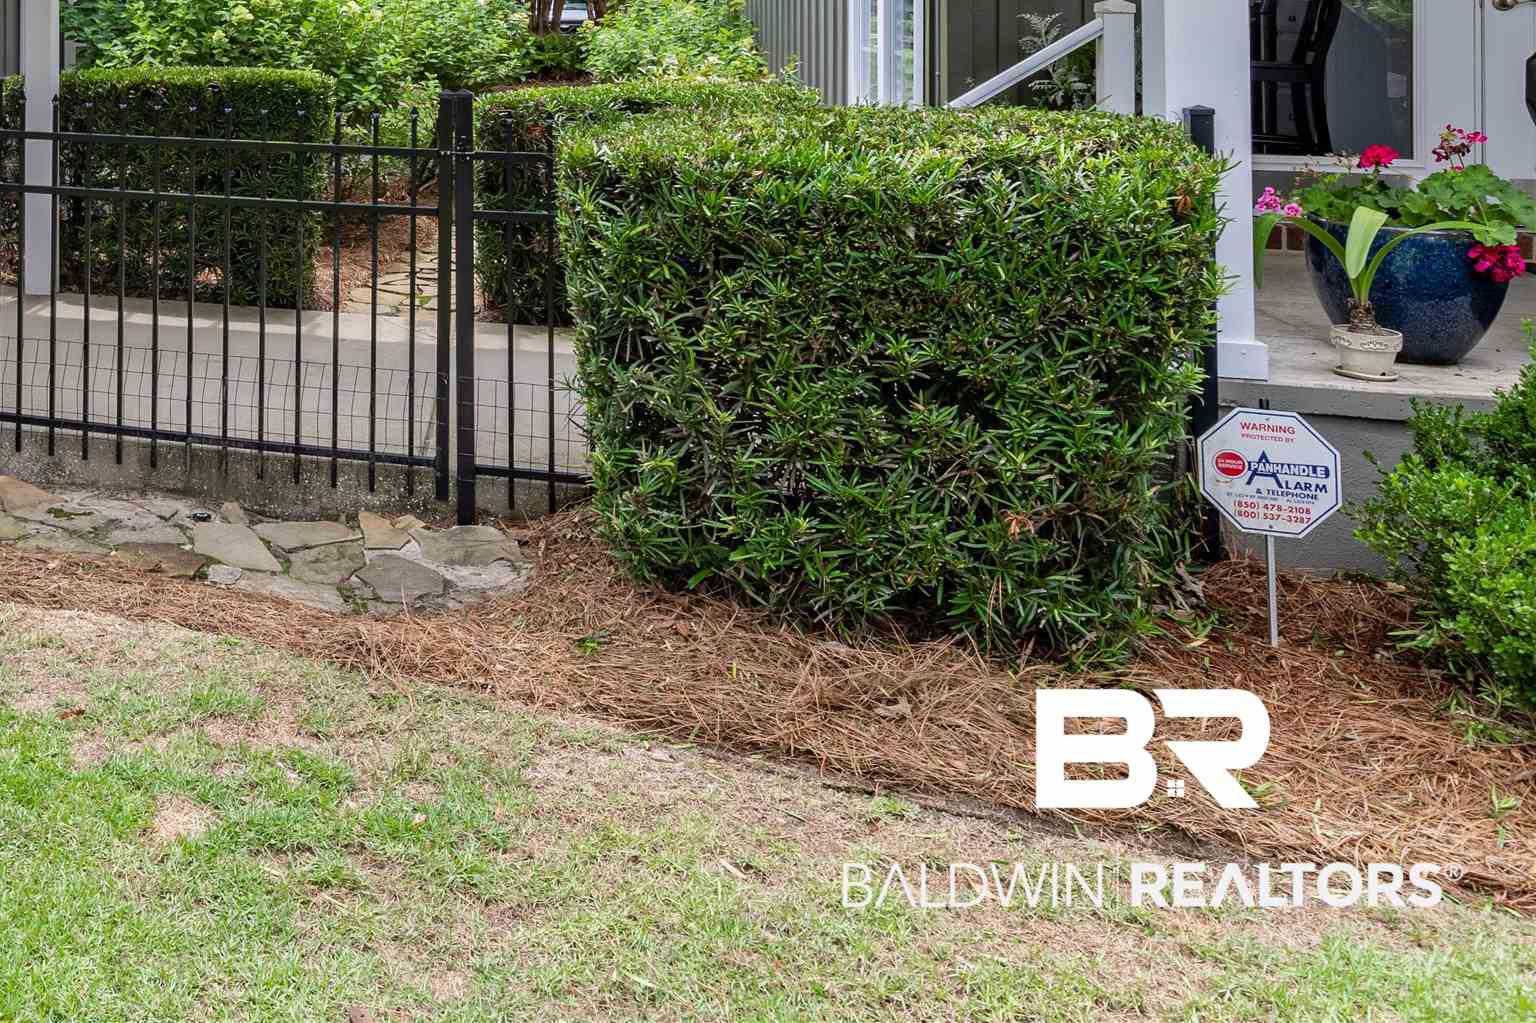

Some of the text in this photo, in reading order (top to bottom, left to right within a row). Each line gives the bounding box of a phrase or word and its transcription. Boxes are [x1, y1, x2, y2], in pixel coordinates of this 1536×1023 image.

[1240, 421, 1296, 435] WARNING
[1241, 434, 1284, 442] PROTECTED
[1250, 461, 1326, 477] PANHANDLE
[1266, 488, 1319, 501] TELEPHONE
[1233, 499, 1312, 515] (850) 478-2108
[1263, 513, 1312, 524] 537-3287
